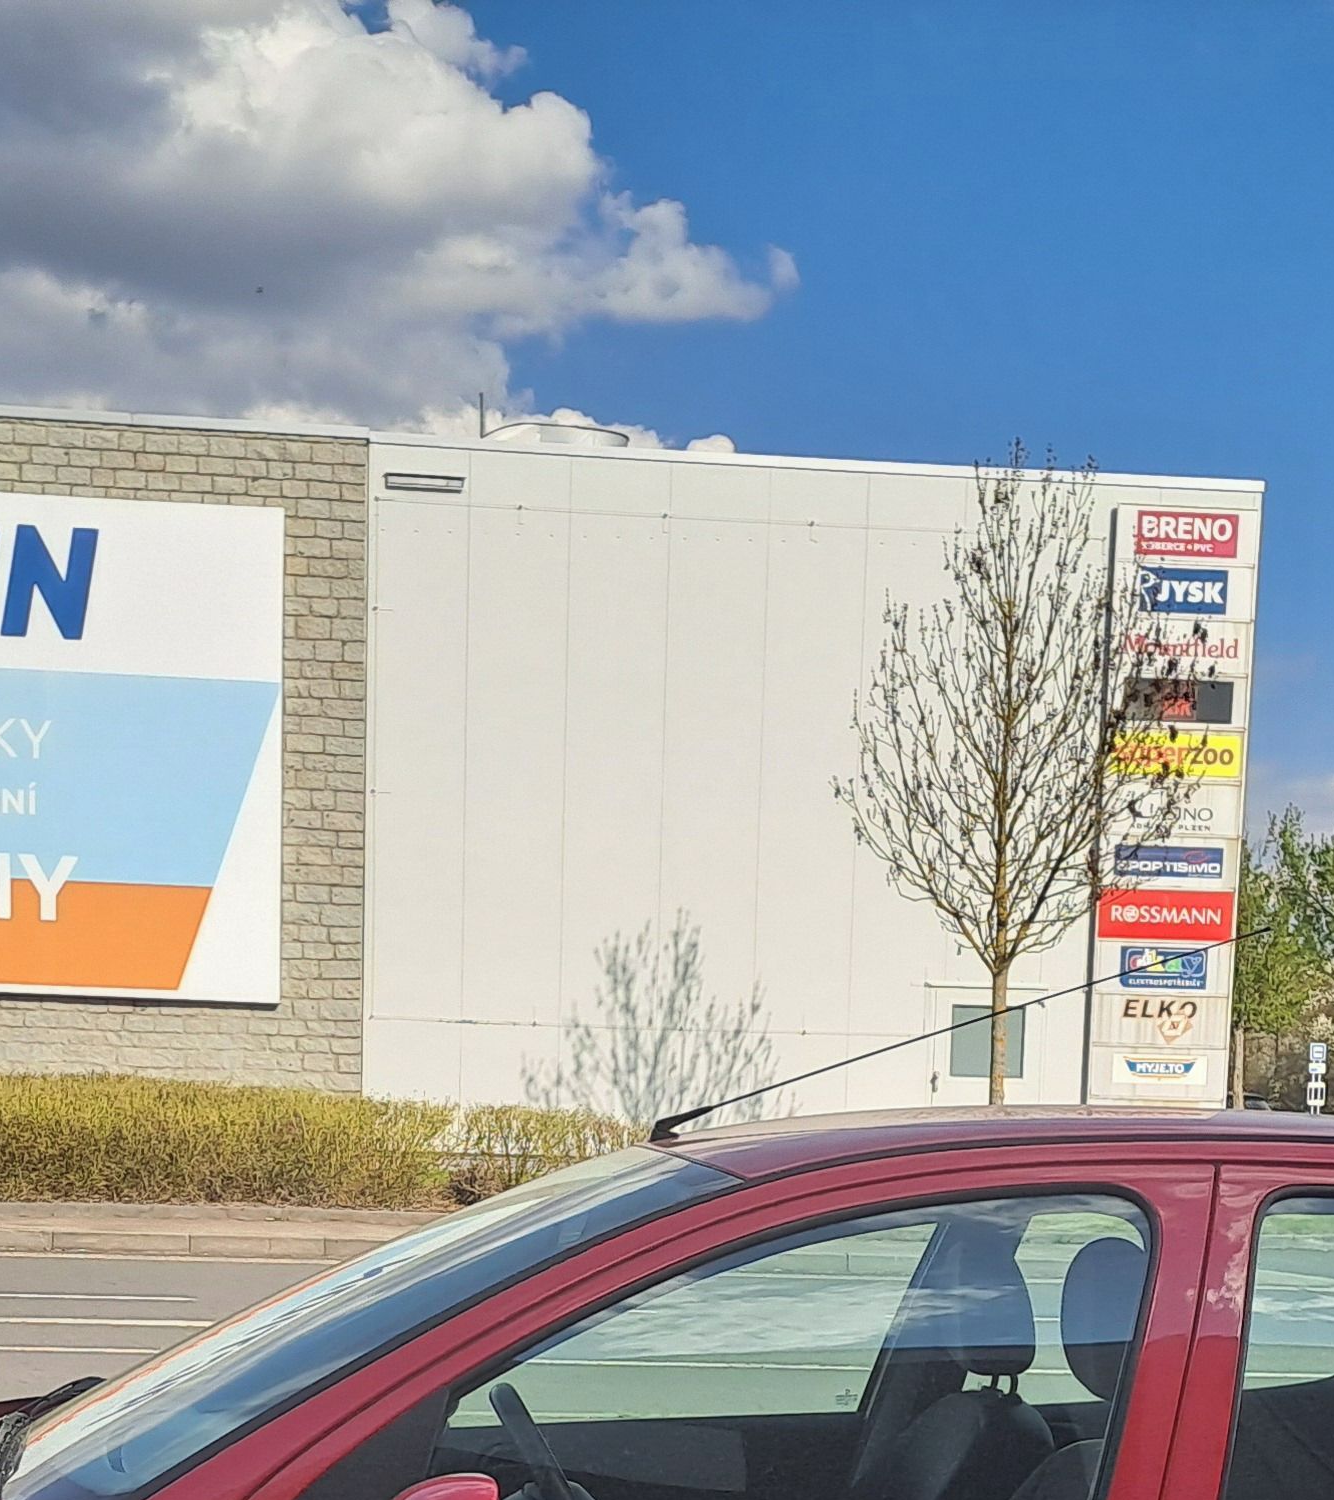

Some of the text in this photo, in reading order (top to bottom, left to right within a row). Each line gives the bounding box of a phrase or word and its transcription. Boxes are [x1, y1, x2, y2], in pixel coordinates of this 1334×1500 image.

[1141, 515, 1233, 542] BRENO
[1193, 543, 1214, 553] PVC
[1156, 580, 1224, 604] JYSK
[1110, 904, 1222, 926] ROSSMANN
[1123, 999, 1198, 1019] ELKO
